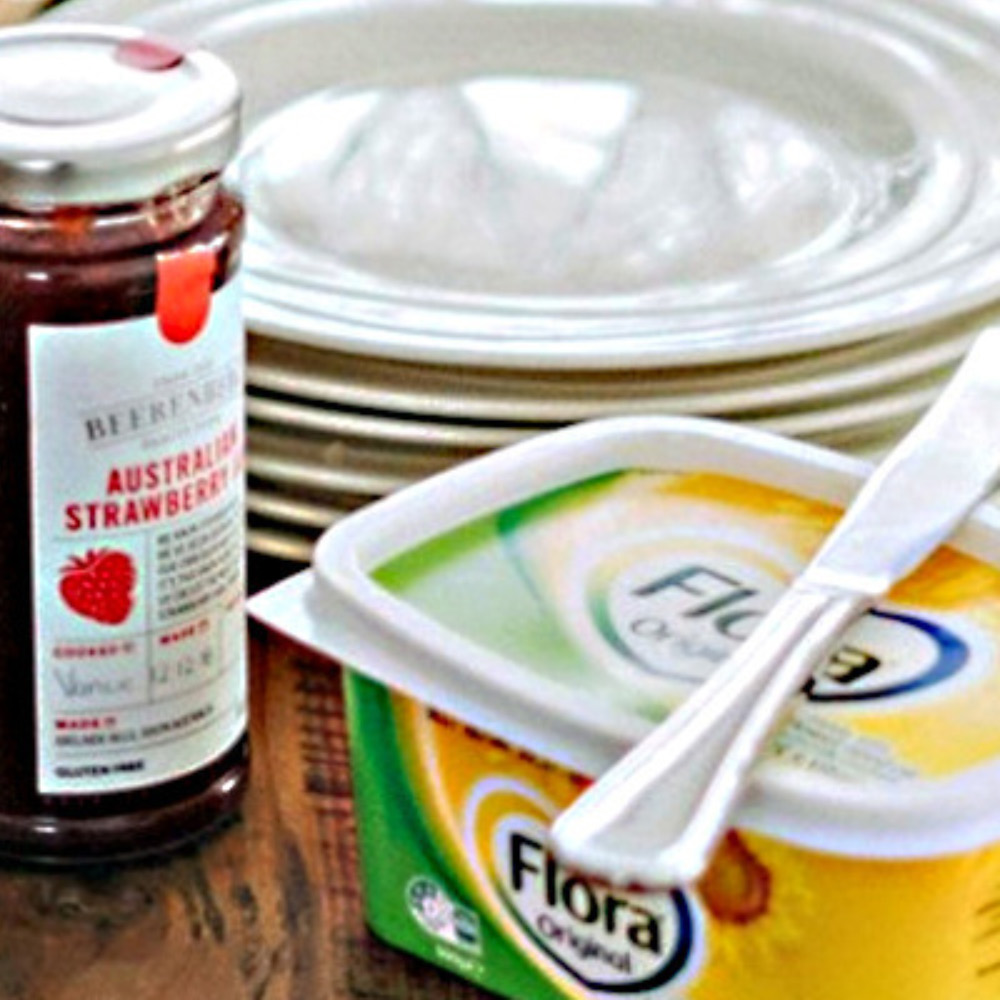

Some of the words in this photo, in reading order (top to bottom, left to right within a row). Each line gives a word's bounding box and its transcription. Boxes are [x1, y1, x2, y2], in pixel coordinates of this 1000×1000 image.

[64, 468, 228, 531] STRAWBERRY
[509, 831, 663, 955] Flora
[536, 913, 632, 974] Original
